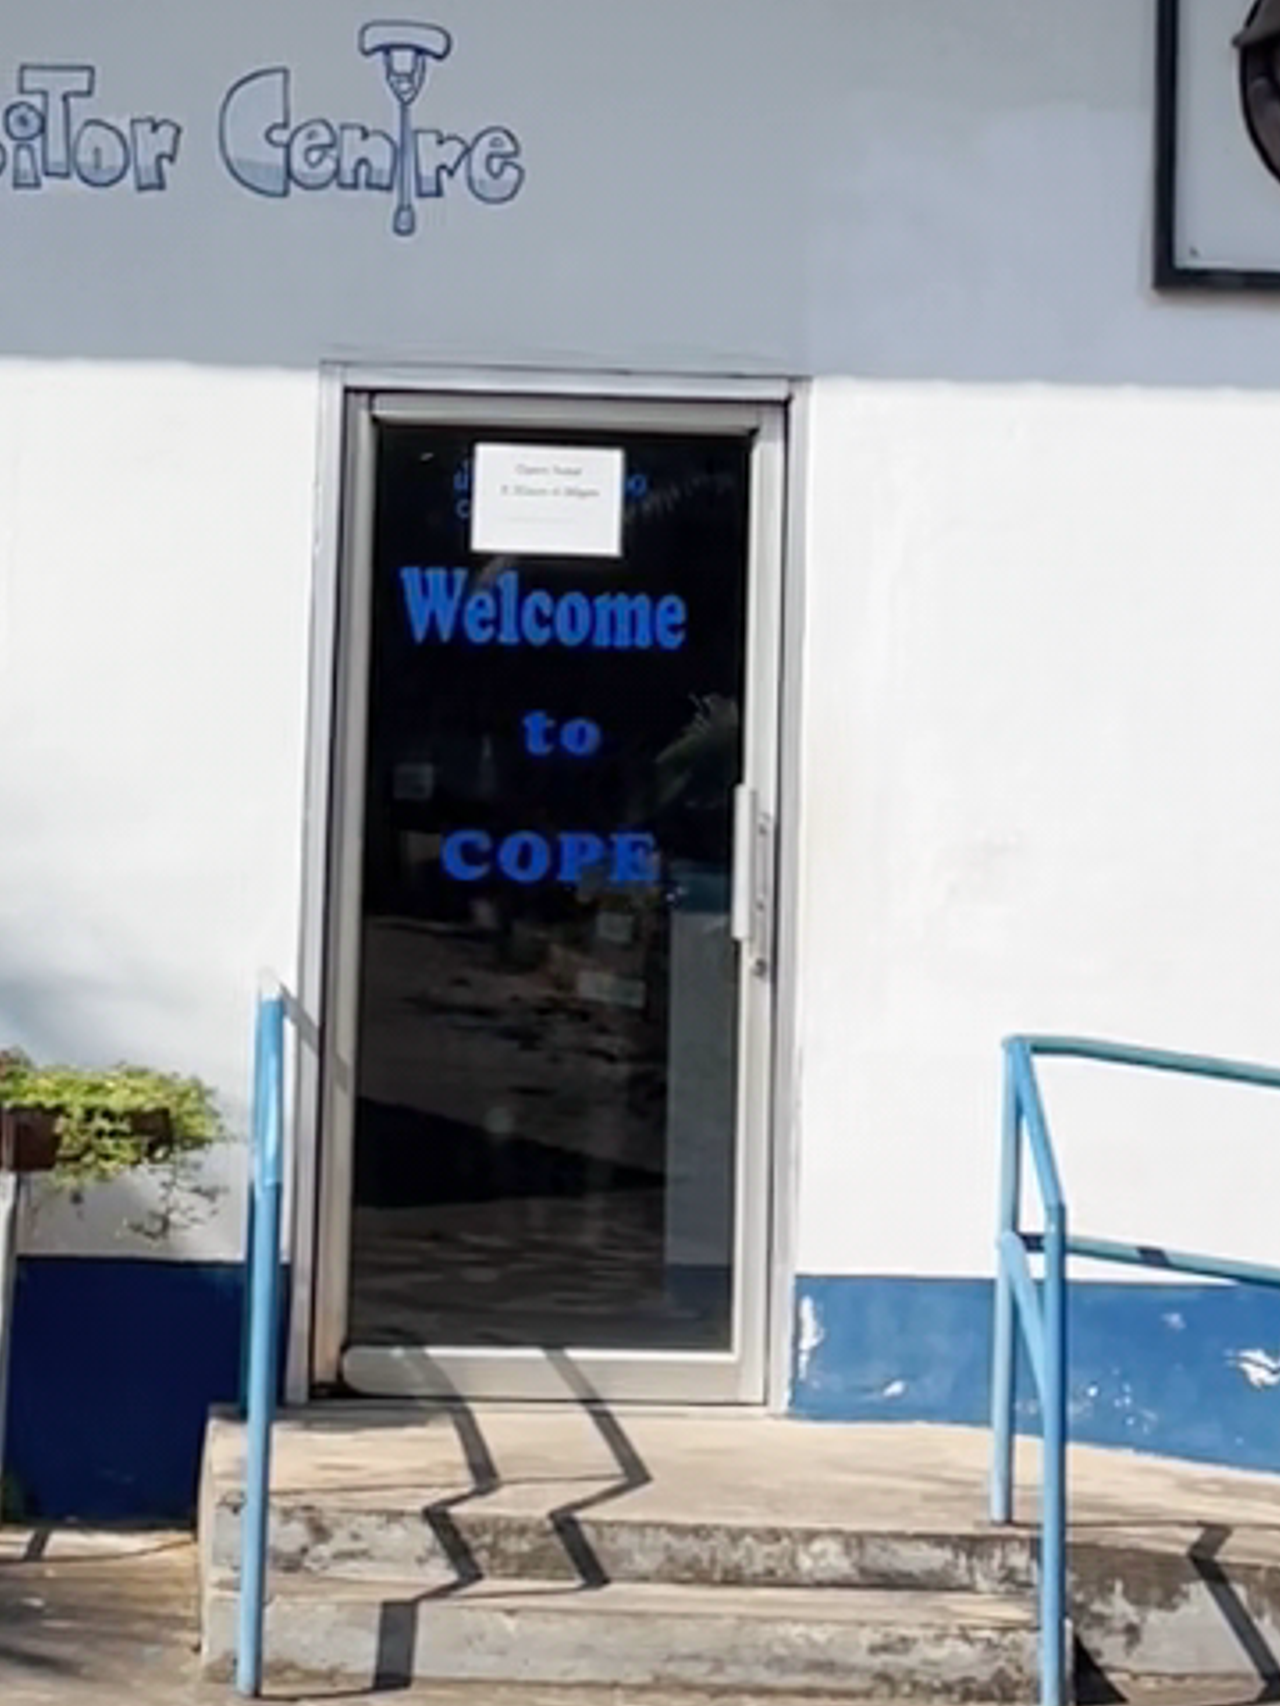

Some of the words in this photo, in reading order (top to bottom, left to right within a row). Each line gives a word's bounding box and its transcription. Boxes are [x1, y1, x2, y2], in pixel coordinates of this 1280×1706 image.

[399, 565, 687, 649] Welcome
[522, 710, 601, 756] to
[440, 829, 662, 882] COPE
